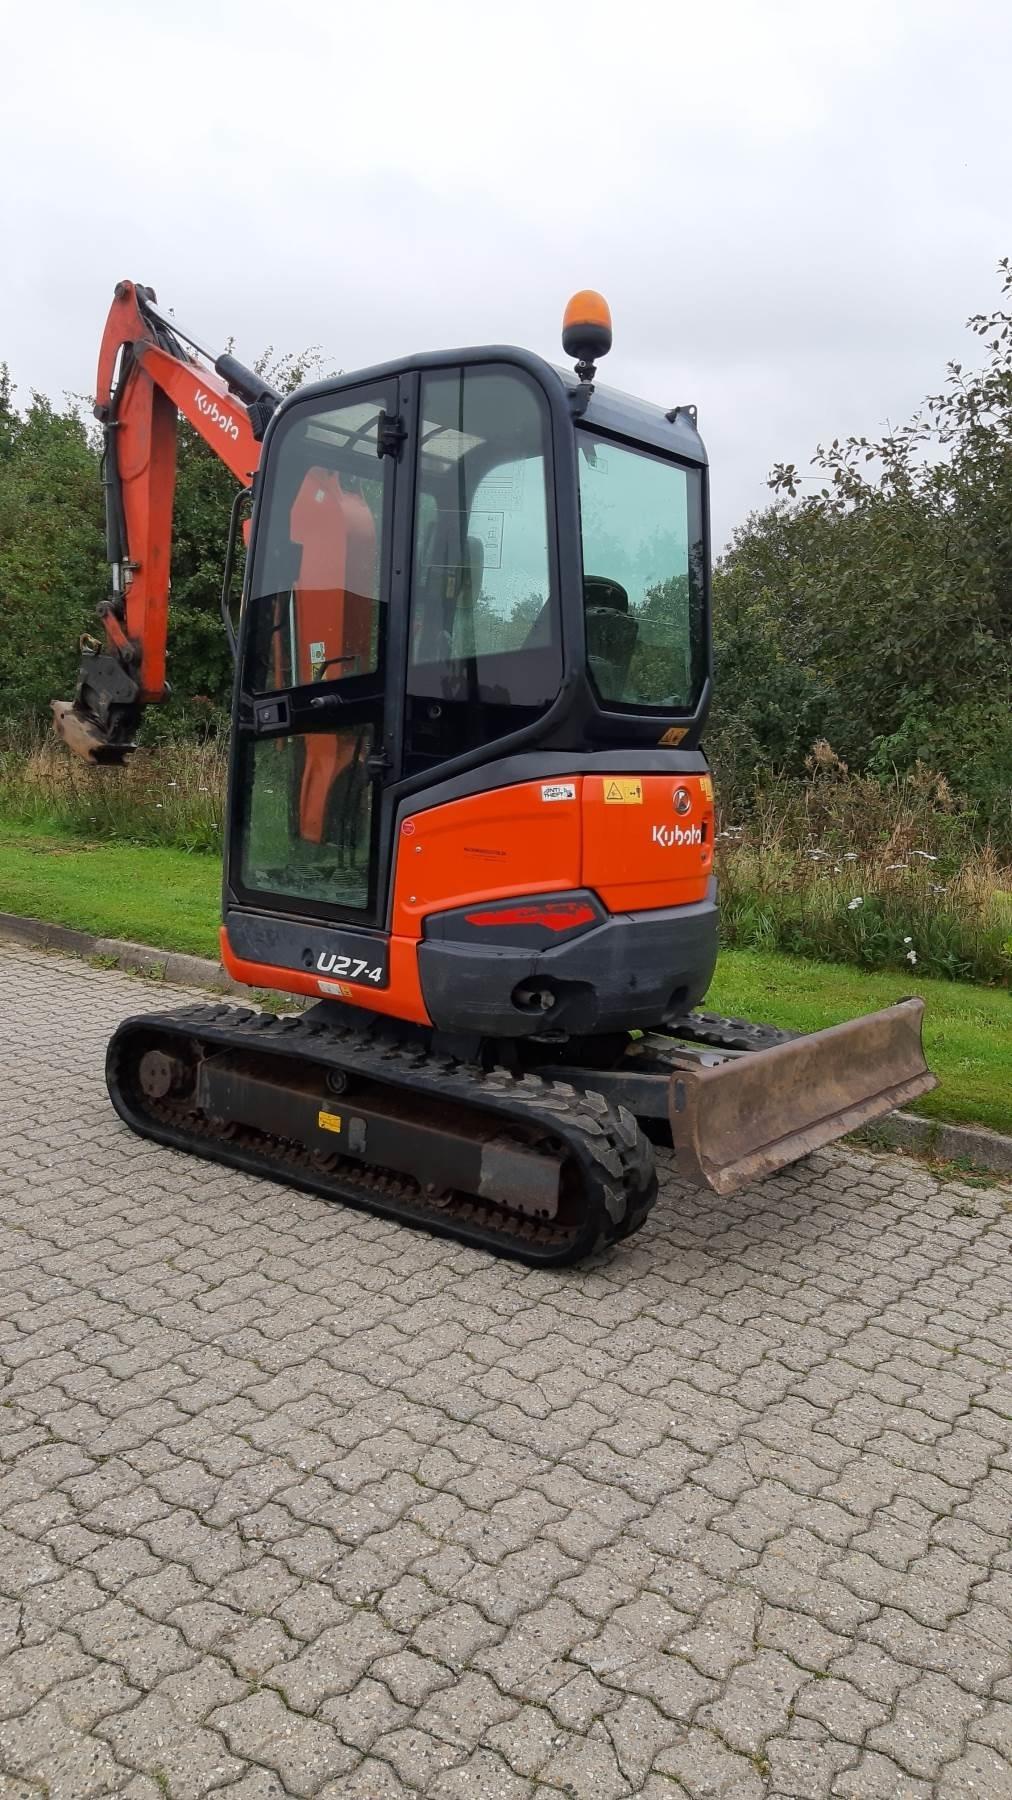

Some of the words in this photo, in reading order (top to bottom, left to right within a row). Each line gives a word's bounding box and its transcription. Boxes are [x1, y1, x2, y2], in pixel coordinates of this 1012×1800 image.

[194, 389, 239, 441] Kubota
[652, 823, 702, 847] Kubota
[316, 952, 383, 982] U27-4
